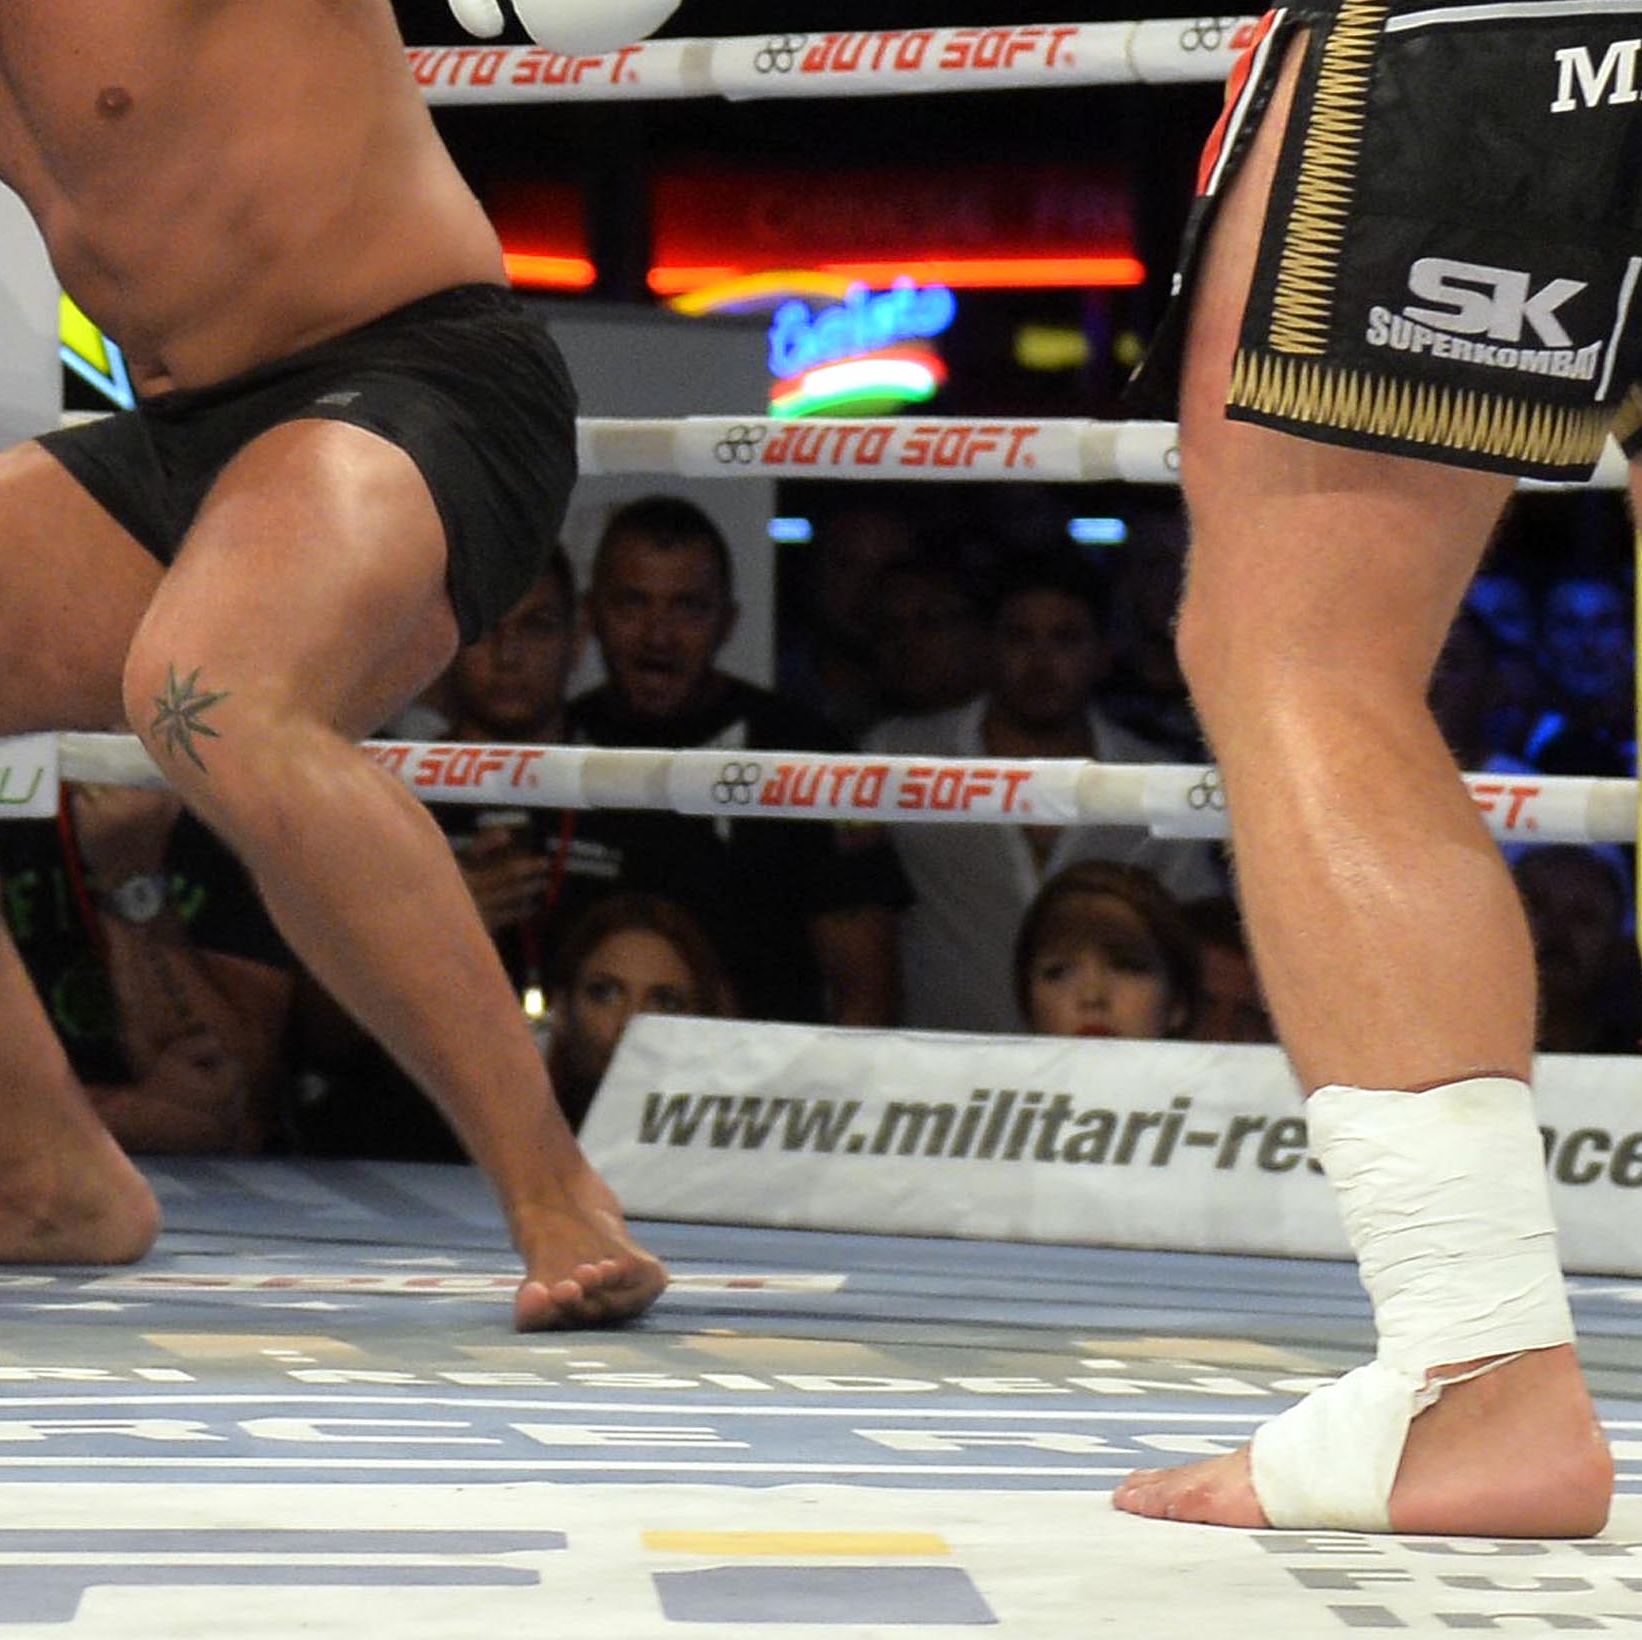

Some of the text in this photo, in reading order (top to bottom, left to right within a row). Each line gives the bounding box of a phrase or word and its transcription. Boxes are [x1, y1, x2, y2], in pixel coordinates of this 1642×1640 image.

[1403, 257, 1588, 348] SK
[1366, 305, 1603, 381] SUPERKOMBA
[286, 1369, 1329, 1396] RESIDEN
